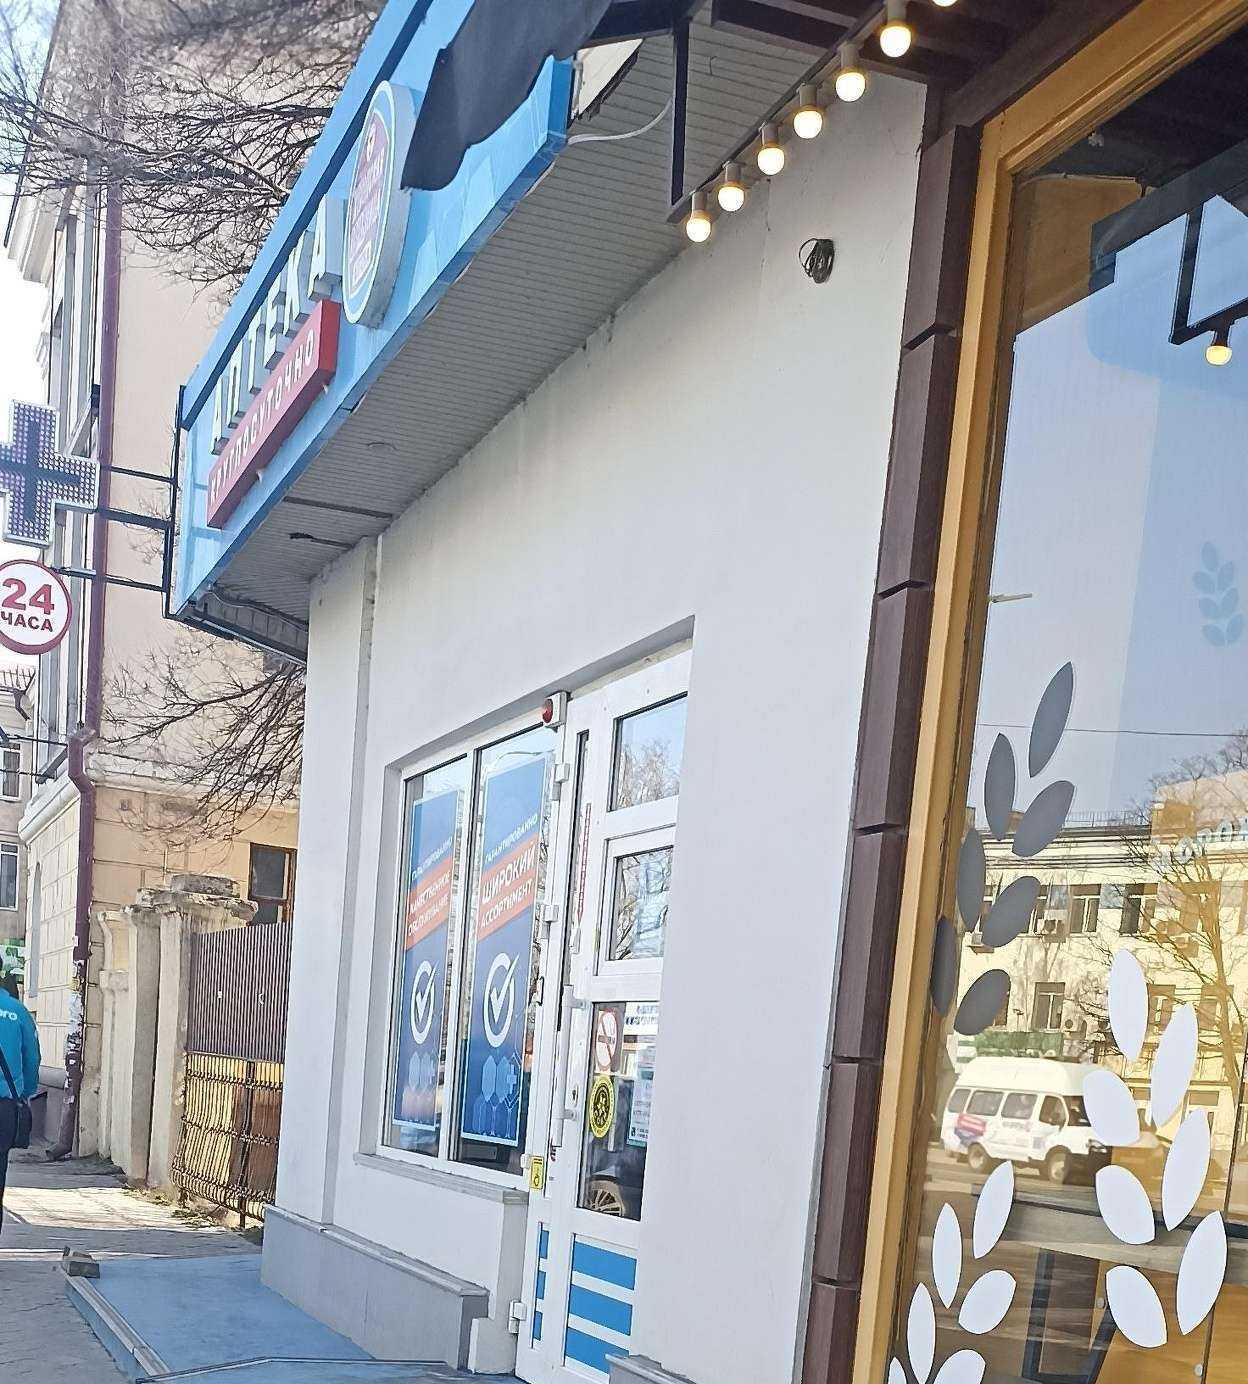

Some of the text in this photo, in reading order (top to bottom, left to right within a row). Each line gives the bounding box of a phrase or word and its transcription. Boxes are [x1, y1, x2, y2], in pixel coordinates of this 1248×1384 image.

[210, 192, 329, 455] АПТЕКА
[209, 328, 316, 504] КРУГЛОСУТОЧНО
[0, 610, 54, 633] ЧАСА
[2, 577, 55, 616] 24
[482, 840, 537, 905] ШИРОКИЙ
